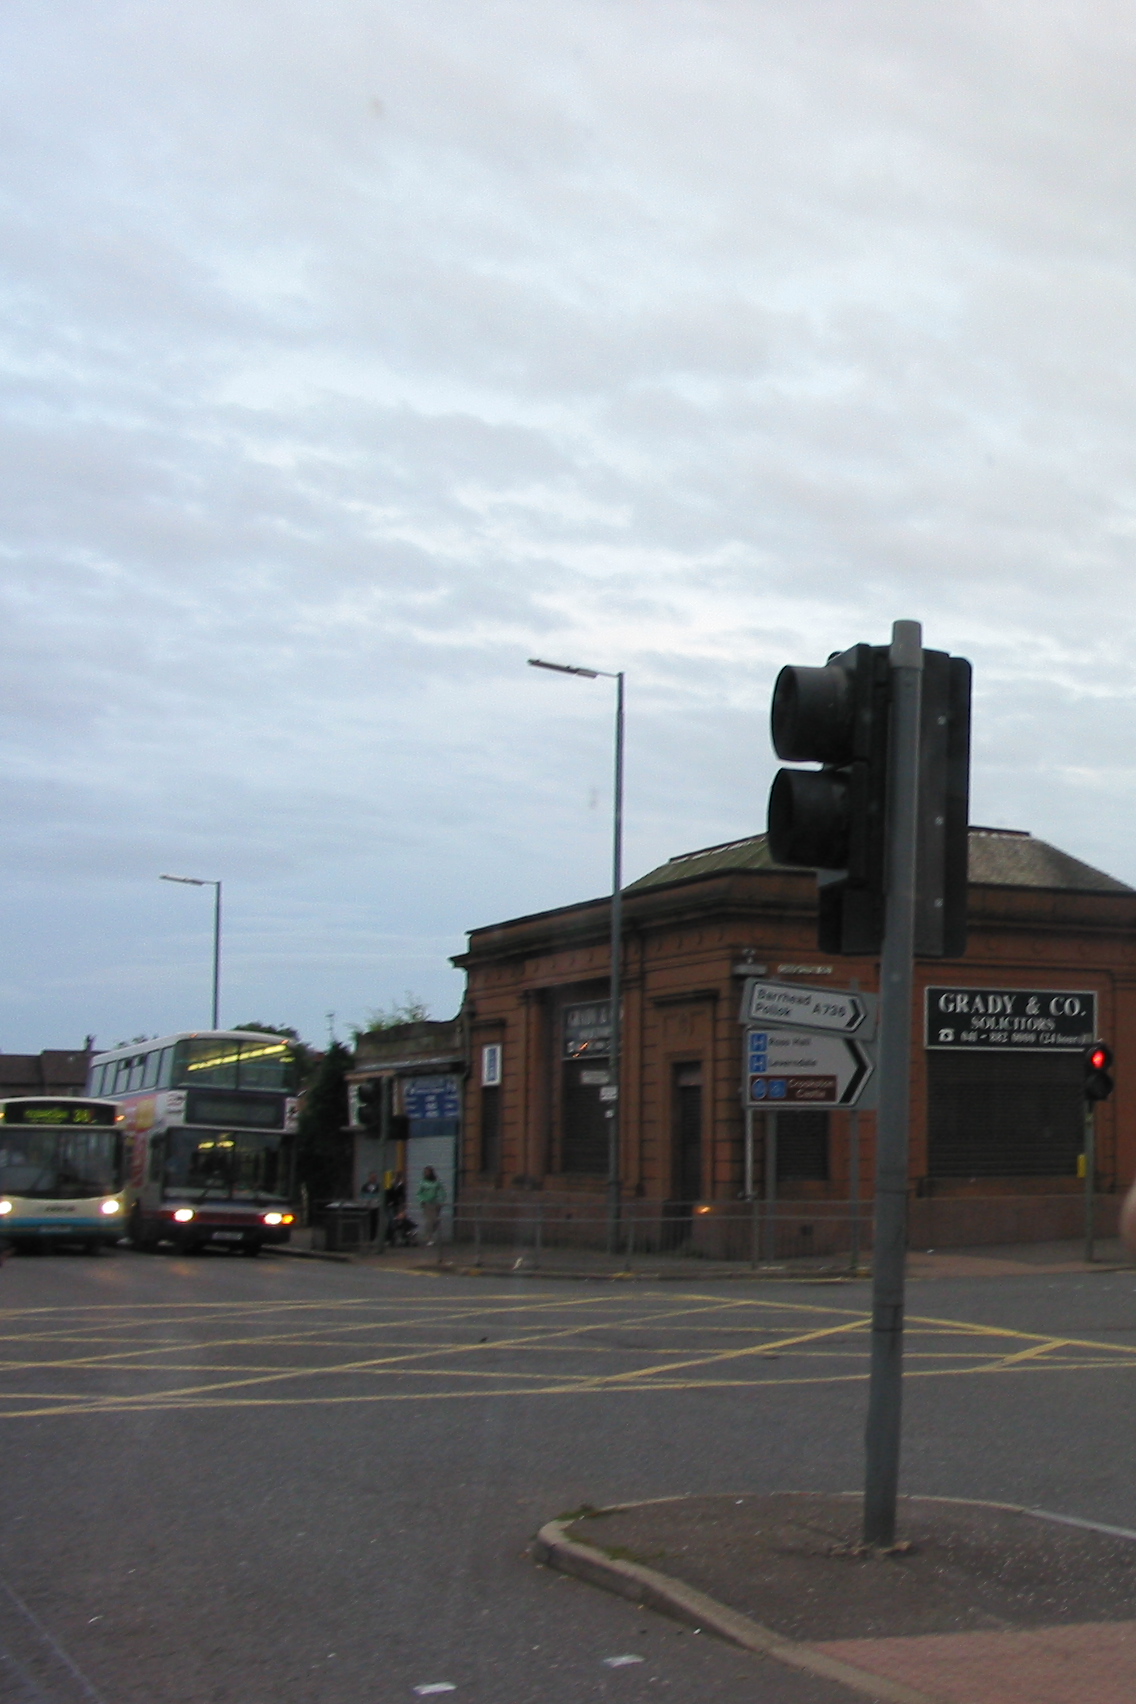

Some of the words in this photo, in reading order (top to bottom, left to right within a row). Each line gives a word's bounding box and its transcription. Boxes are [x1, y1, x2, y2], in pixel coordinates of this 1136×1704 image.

[757, 988, 811, 1005] Barrhead
[938, 992, 1016, 1014] GRADY
[1025, 995, 1041, 1015] &
[1049, 996, 1087, 1017] CO.
[971, 1015, 1056, 1031] SOLICITORS
